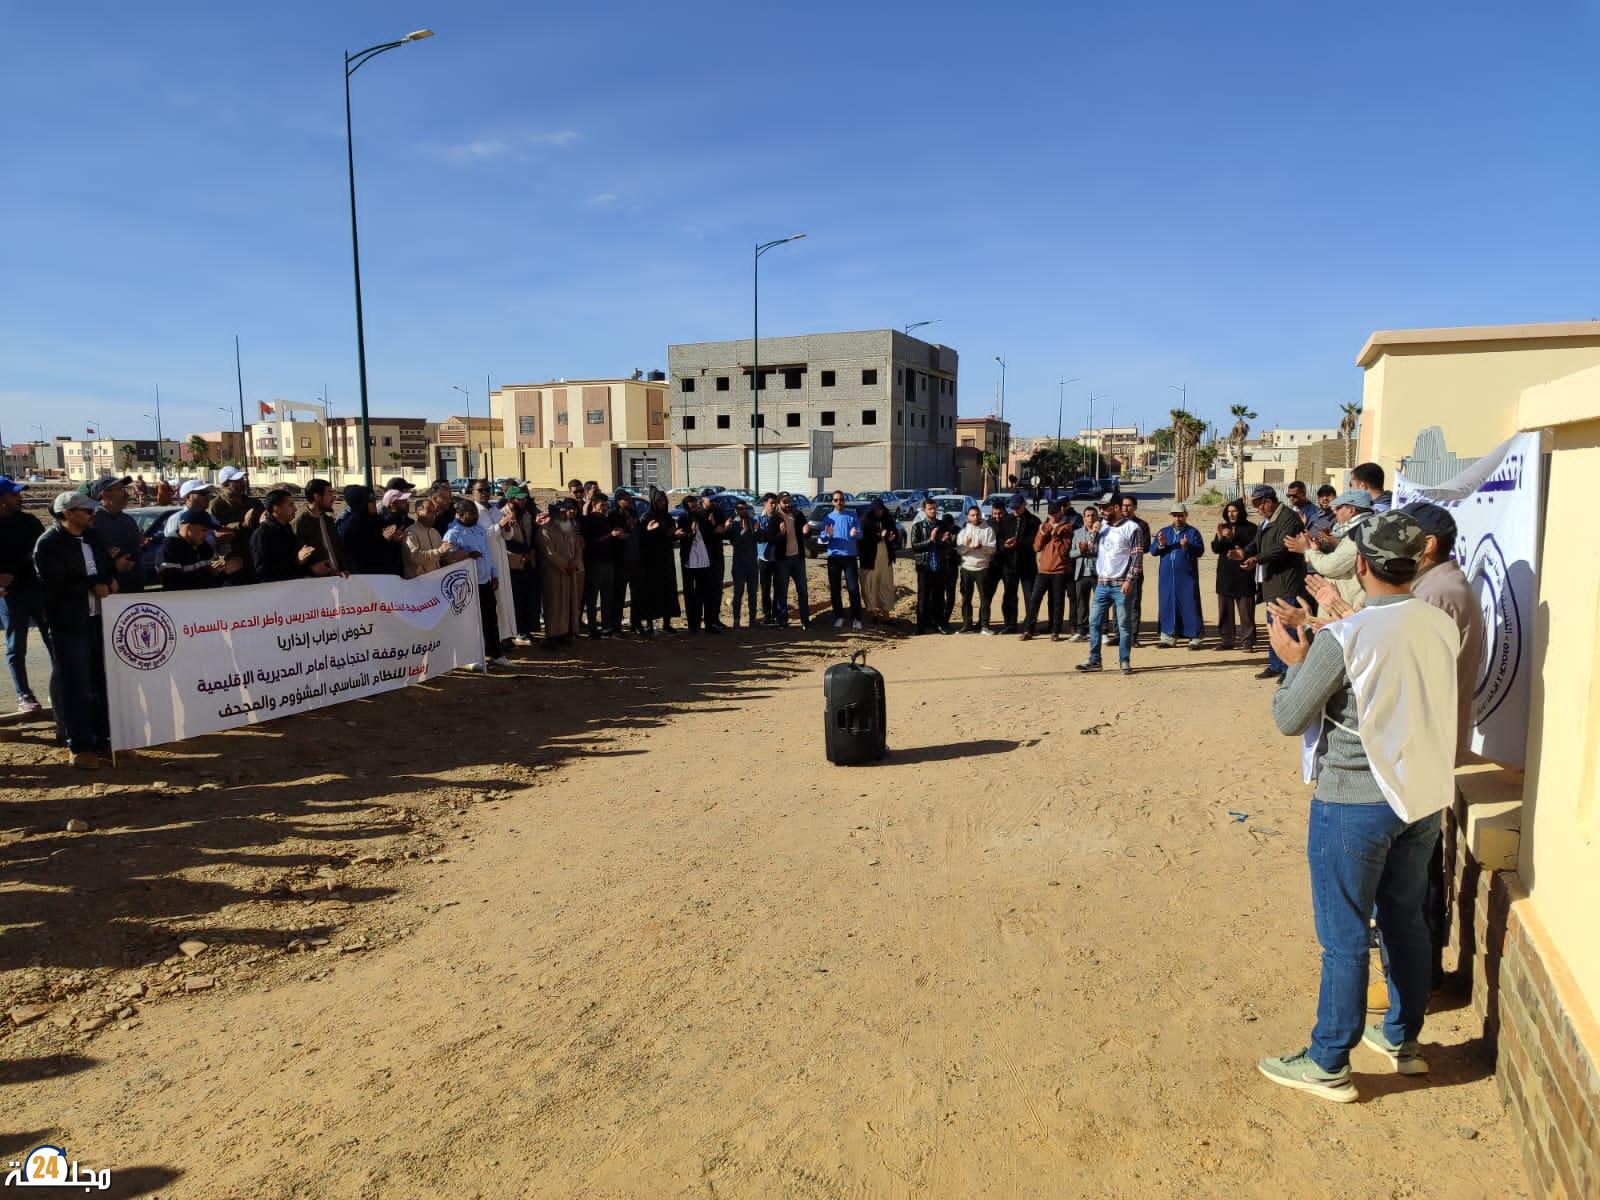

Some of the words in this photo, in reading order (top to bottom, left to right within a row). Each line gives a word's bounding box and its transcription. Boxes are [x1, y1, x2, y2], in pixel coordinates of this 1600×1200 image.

[285, 607, 319, 625] التدريس
[341, 602, 378, 616] الموحدة
[183, 619, 228, 637] بالسمارة
[231, 615, 260, 630] الدعم
[261, 611, 284, 628] وأطر
[277, 631, 310, 651] إنذاريا
[341, 623, 374, 641] تخوض
[372, 647, 409, 660] بوقفة
[411, 640, 441, 656] مرفوقا
[305, 653, 328, 675] أمام
[330, 650, 369, 669] احتجاجية
[197, 670, 254, 694] الإقليمية
[257, 662, 303, 684] المديرية
[372, 666, 407, 686] للنظام
[329, 672, 369, 696] الأساسي
[279, 682, 327, 707] المشؤوم
[218, 694, 276, 718] والمجحف
